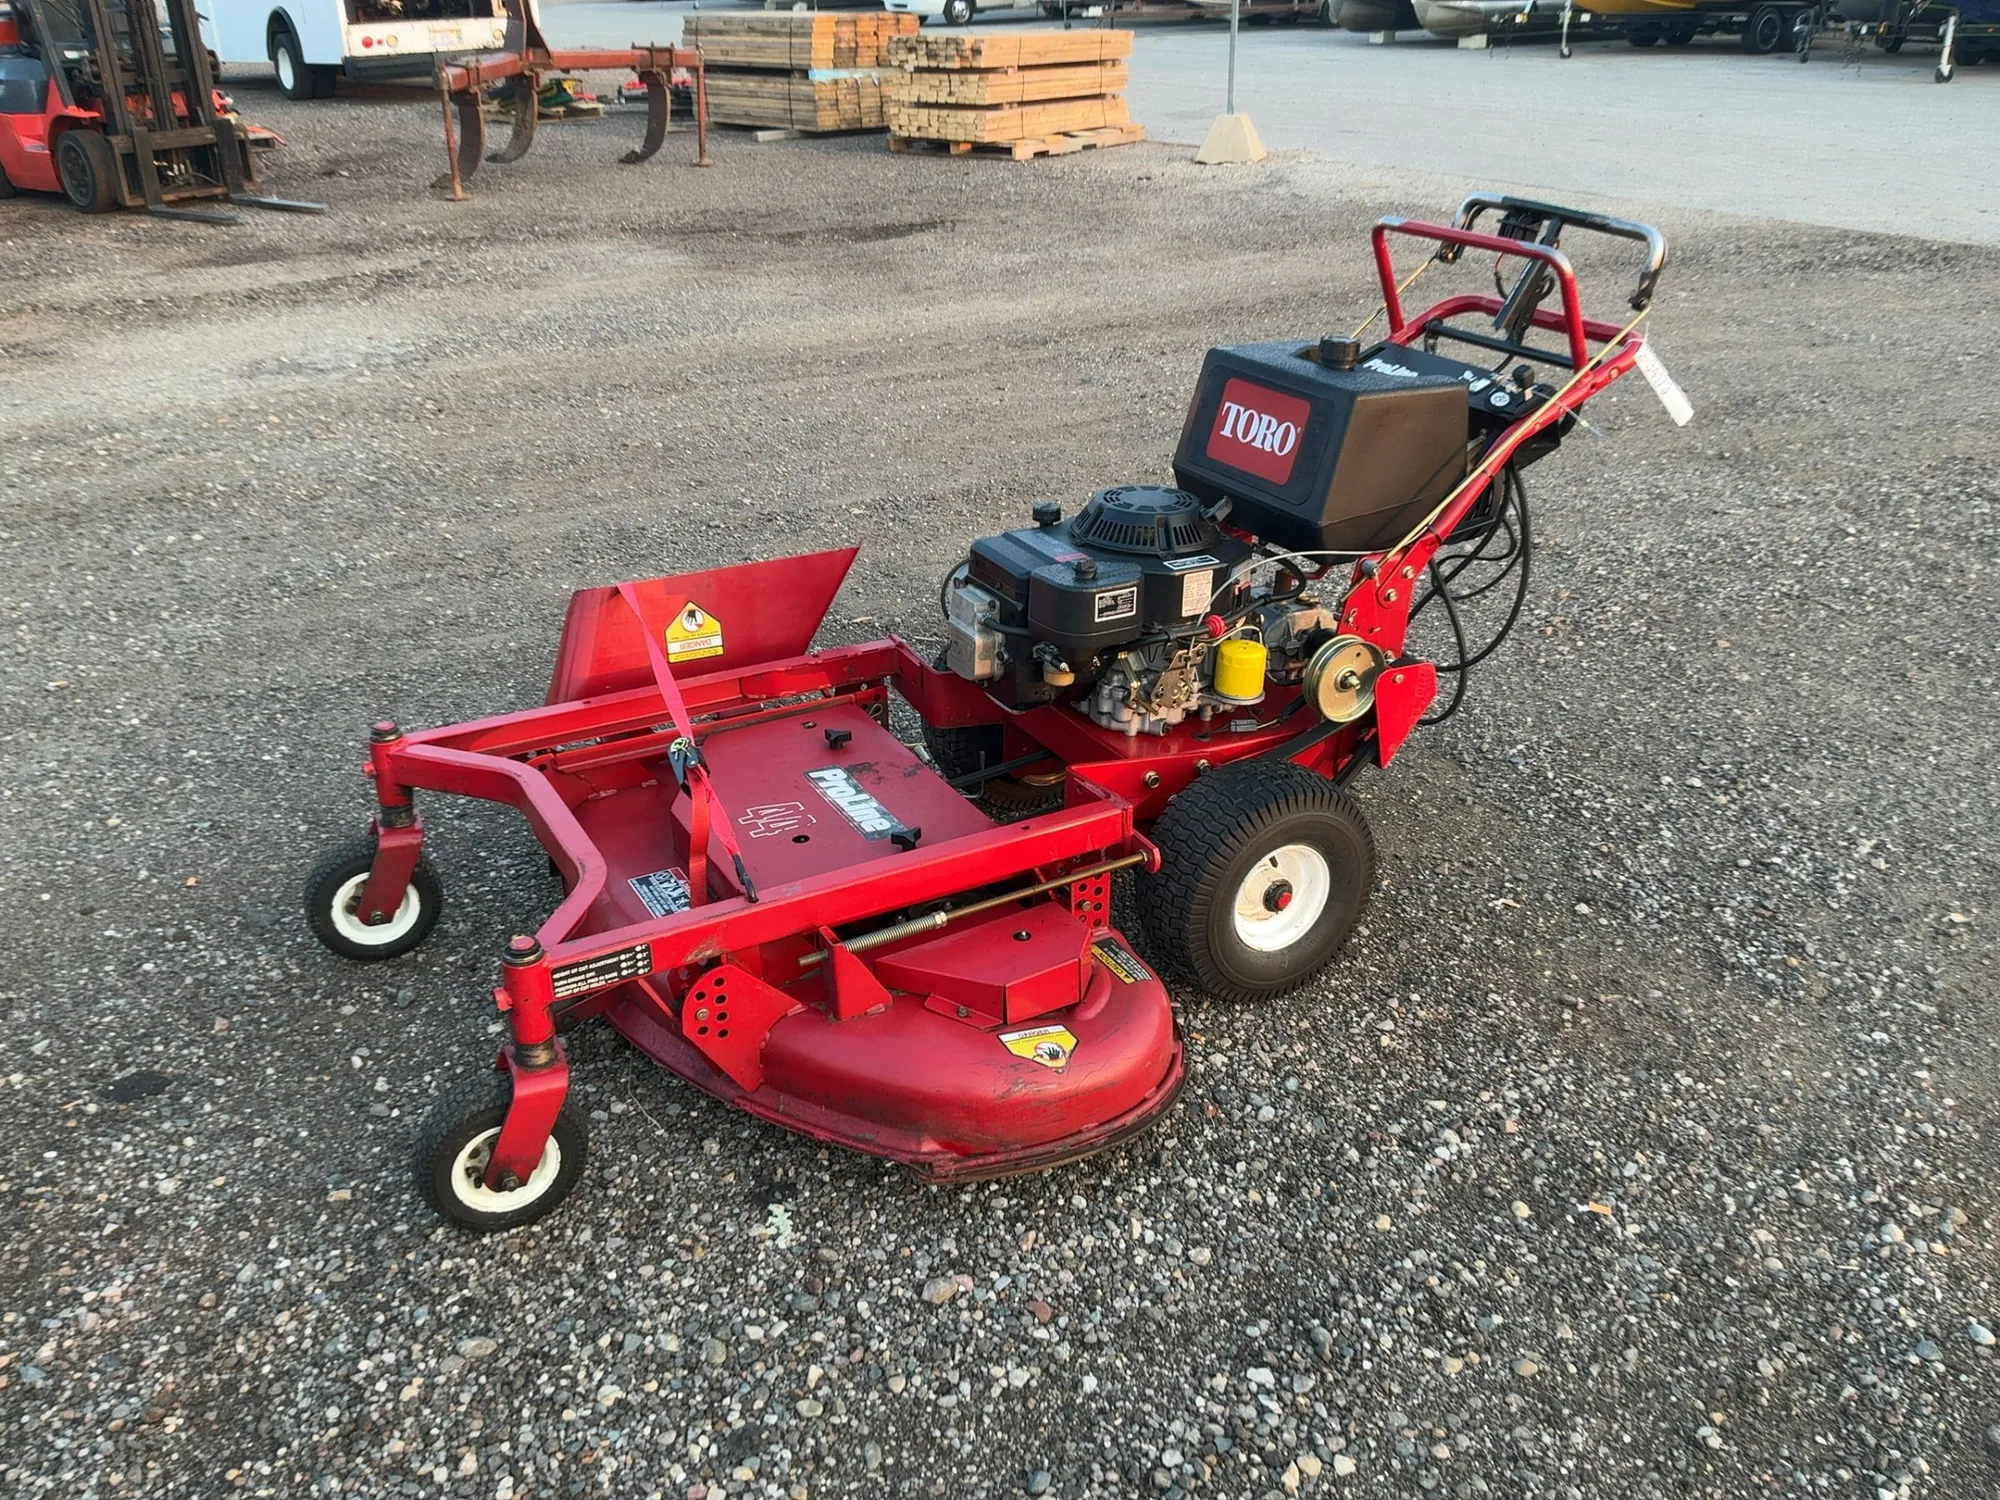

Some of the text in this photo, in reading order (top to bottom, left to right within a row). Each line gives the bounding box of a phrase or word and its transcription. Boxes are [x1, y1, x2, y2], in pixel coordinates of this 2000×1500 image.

[1219, 401, 1297, 456] TORO
[679, 638, 712, 650] DANGER
[807, 768, 892, 832] ProLine
[1097, 952, 1124, 975] CAUTION
